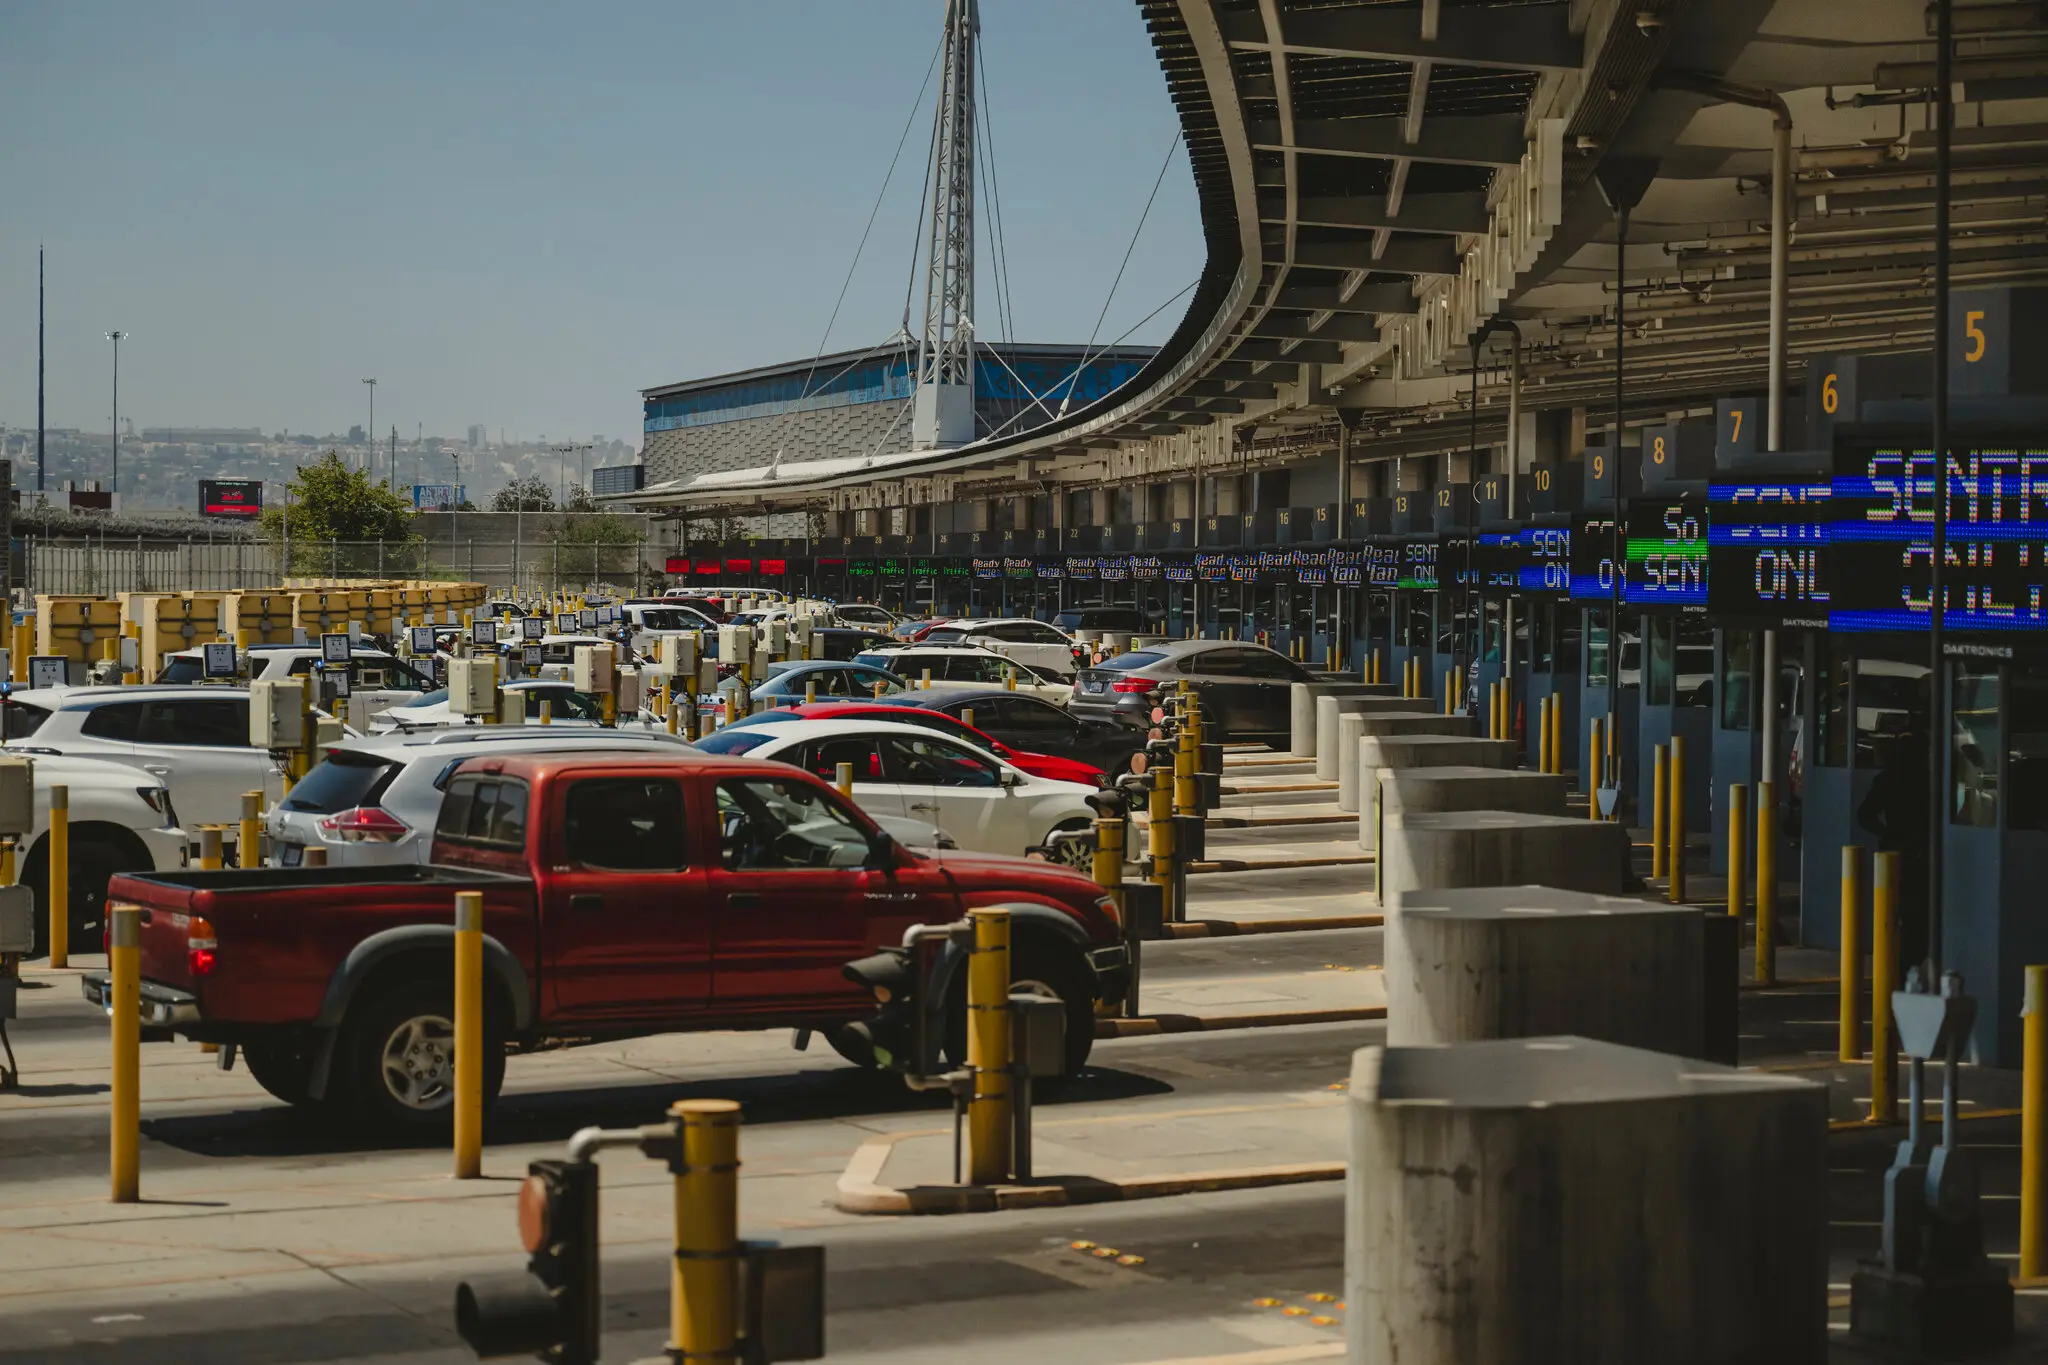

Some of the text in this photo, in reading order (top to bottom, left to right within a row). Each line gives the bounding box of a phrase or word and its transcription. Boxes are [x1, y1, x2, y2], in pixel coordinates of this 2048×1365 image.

[1965, 311, 1986, 362] 5
[1822, 374, 1838, 414] 6
[1730, 411, 1743, 442] 7
[1653, 436, 1665, 464] 8
[1593, 456, 1604, 480] 9
[1535, 470, 1550, 491] 10
[1438, 489, 1450, 507] 12
[1485, 481, 1497, 500] 11
[1355, 503, 1366, 518] 14
[1396, 497, 1407, 513] 13
[1280, 512, 1289, 525] 16
[1316, 507, 1326, 521] 15
[1172, 522, 1181, 533] 19
[1208, 519, 1216, 530] 18
[1245, 516, 1253, 528] 17
[1004, 531, 1012, 540] 24
[1037, 529, 1045, 539] 23
[1070, 528, 1078, 538] 22
[1104, 527, 1112, 537] 21
[1532, 530, 1570, 556] SEN
[1943, 643, 2013, 658] DAKTRONICS
